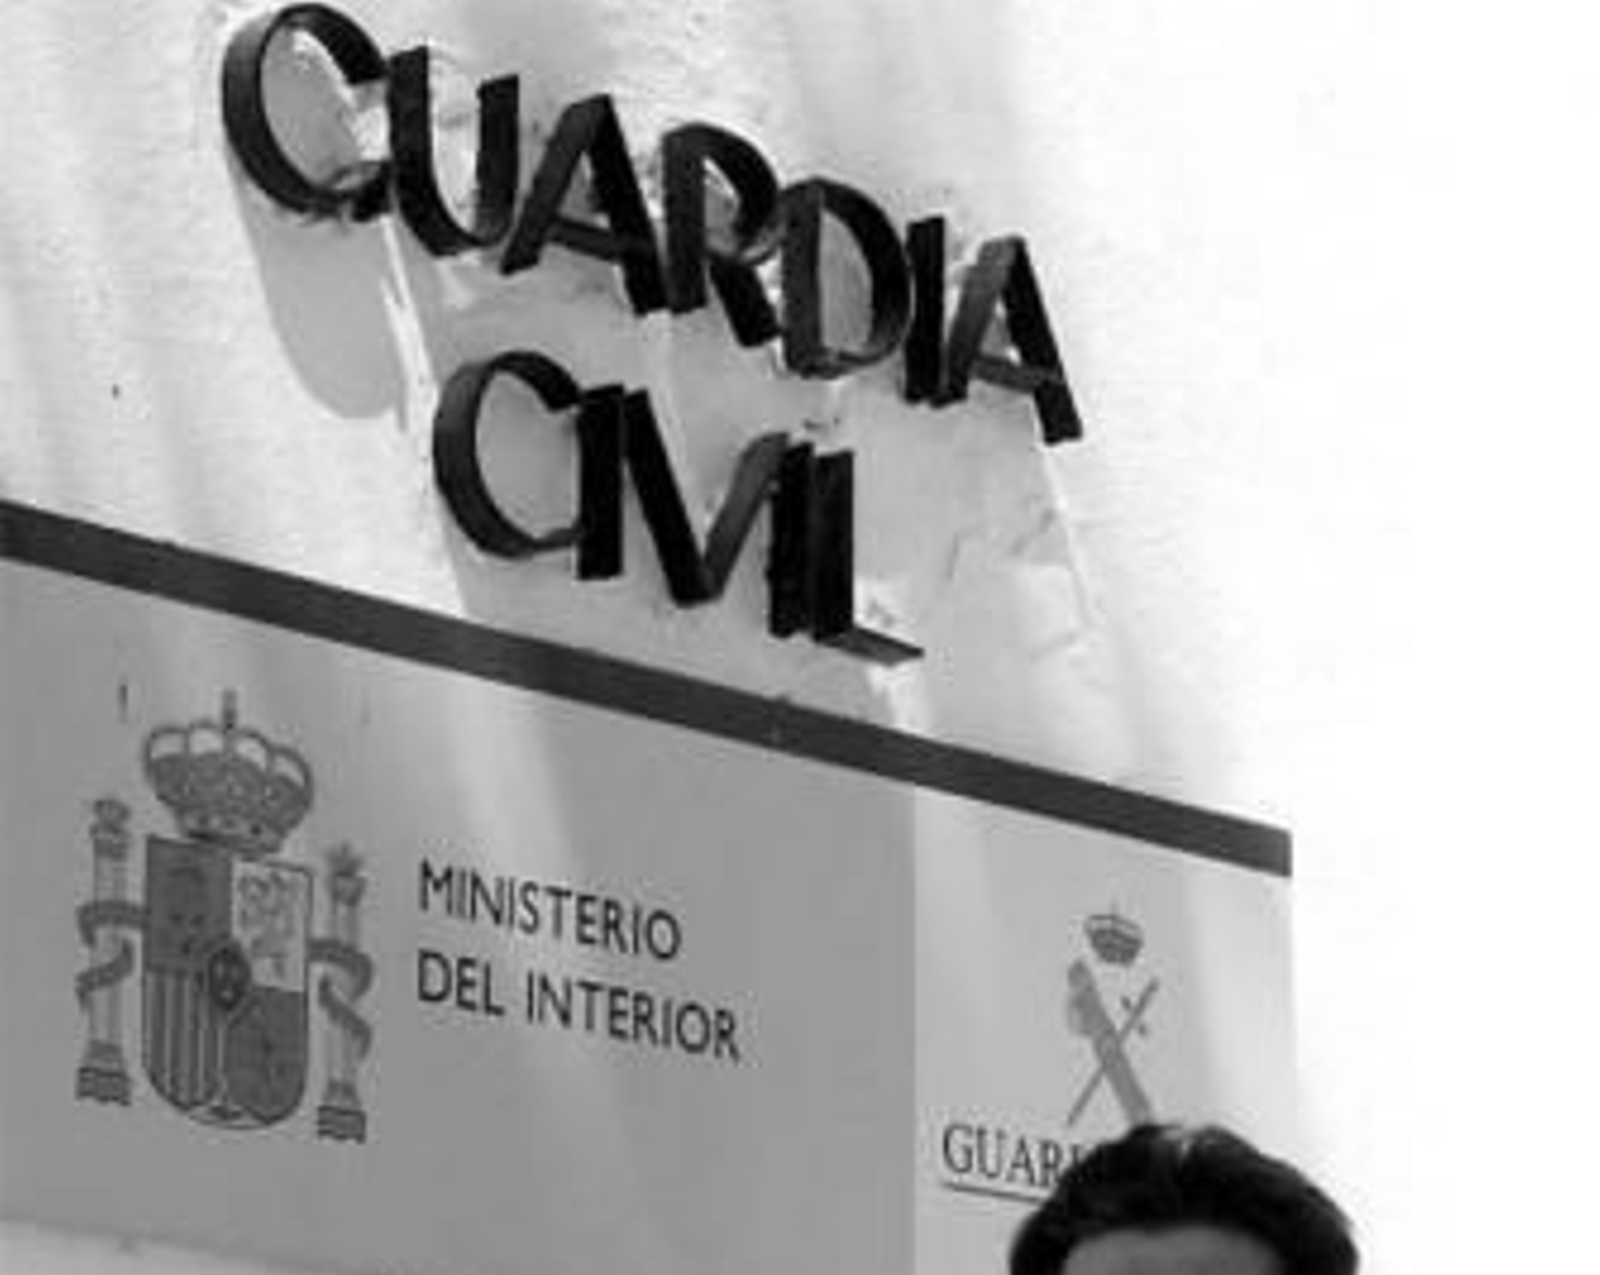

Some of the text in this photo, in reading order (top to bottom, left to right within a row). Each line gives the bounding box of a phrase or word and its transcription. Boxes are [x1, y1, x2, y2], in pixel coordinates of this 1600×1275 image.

[221, 2, 1083, 446] GUARDIA
[433, 351, 925, 667] CIVIL
[417, 949, 740, 1063] DEL INTERIOR
[418, 857, 682, 960] MINISTERIO
